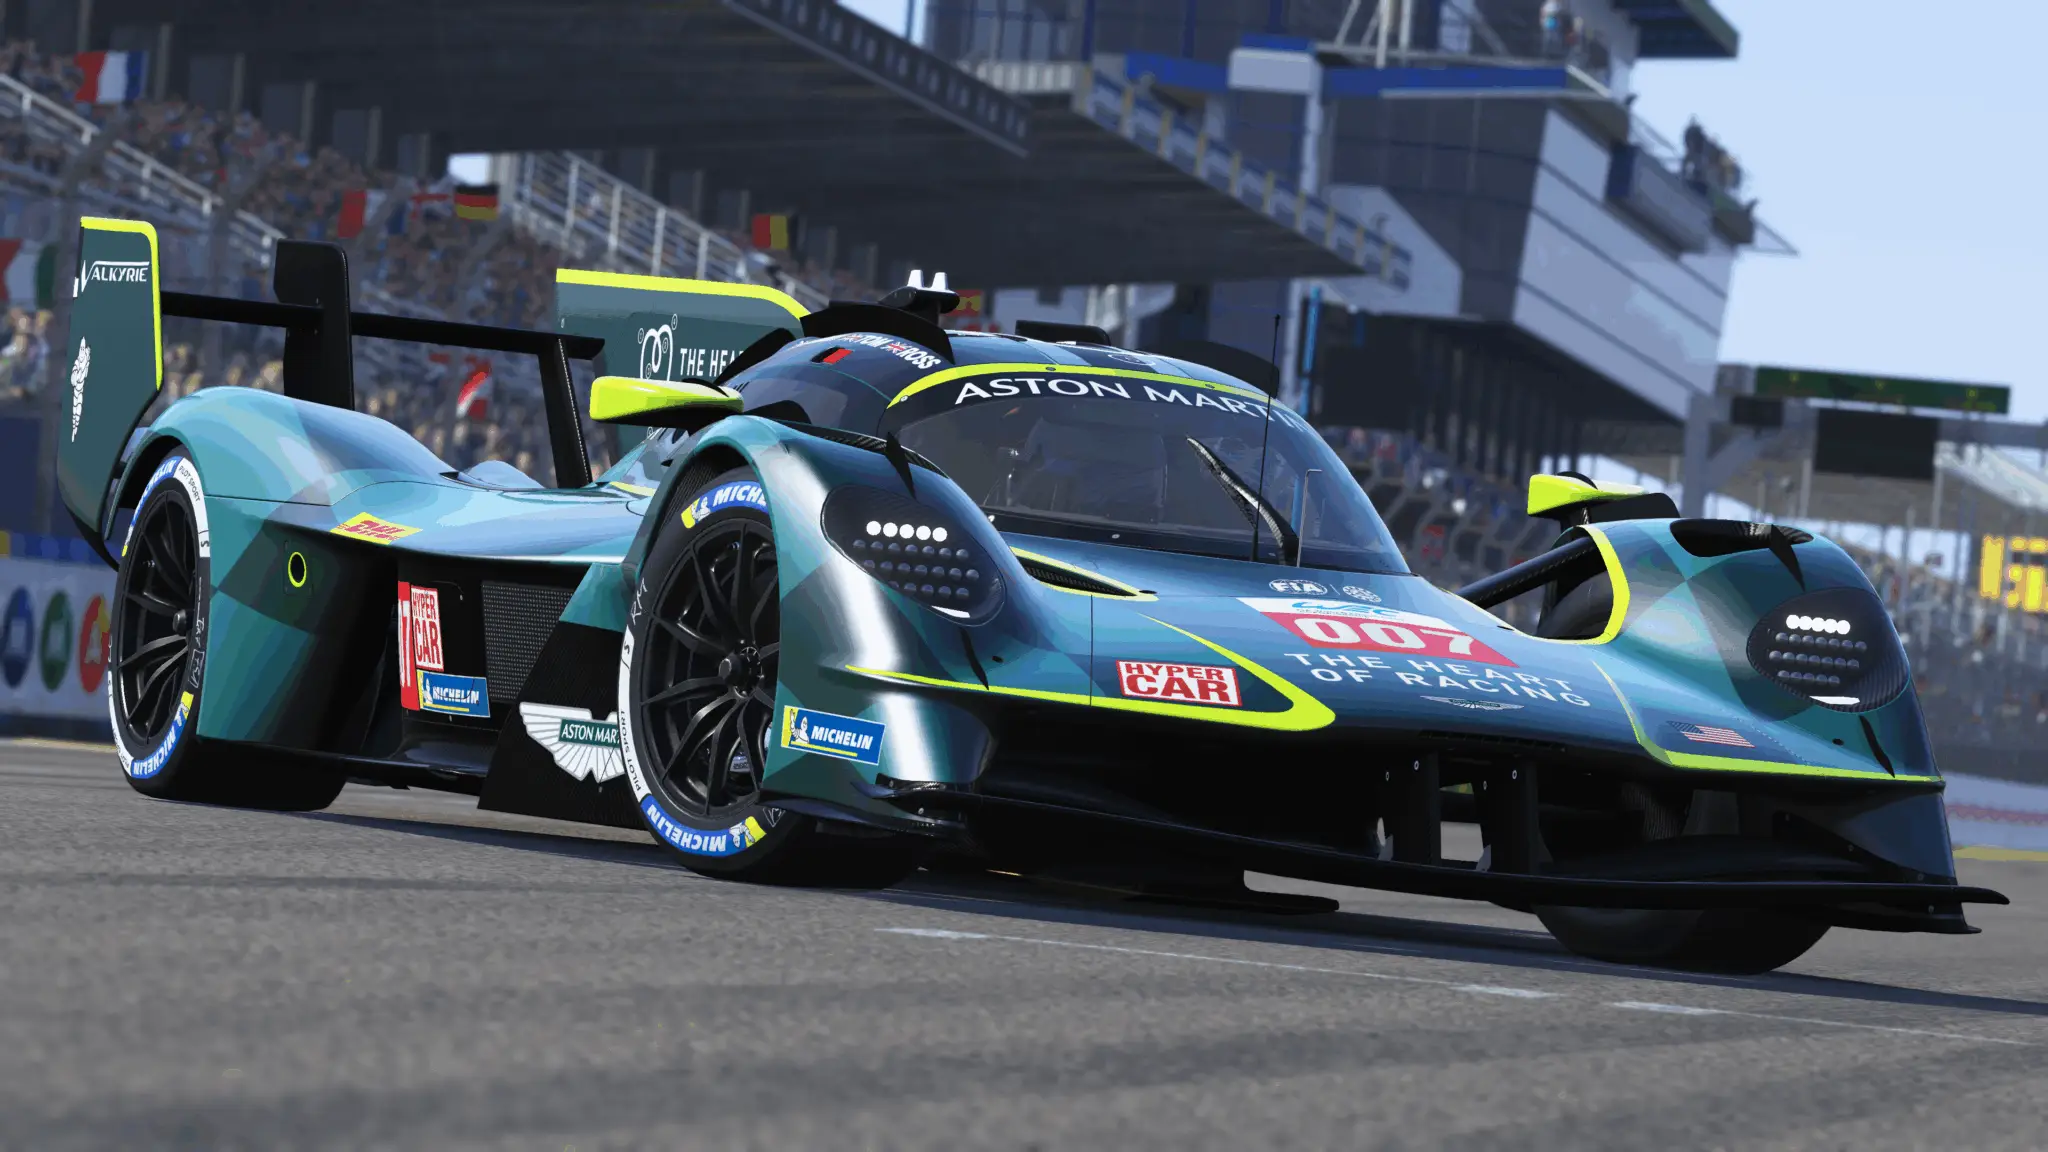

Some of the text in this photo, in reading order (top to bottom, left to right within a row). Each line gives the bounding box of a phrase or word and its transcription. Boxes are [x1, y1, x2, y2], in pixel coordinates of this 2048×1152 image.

[81, 260, 150, 292] VALKYRIE
[680, 347, 706, 377] THE
[896, 346, 942, 370] ROSS
[954, 378, 1132, 405] ASTON
[188, 477, 201, 502] SPORT
[411, 591, 437, 620] HYPER
[414, 617, 441, 665] CAR
[1293, 617, 1475, 656] 007
[1124, 663, 1226, 681] HYPER
[1284, 652, 1573, 692] THE HEART
[432, 686, 480, 705] MICHELIN
[1126, 674, 1232, 702] CAR
[1310, 668, 1374, 683] OF
[1395, 671, 1591, 707] RACING
[561, 723, 594, 741] ASTON
[811, 725, 873, 750] MICHELIN
[133, 725, 177, 776] MICHELIN
[620, 709, 641, 792] PILOT SPORT
[646, 804, 727, 852] MICHELIN
